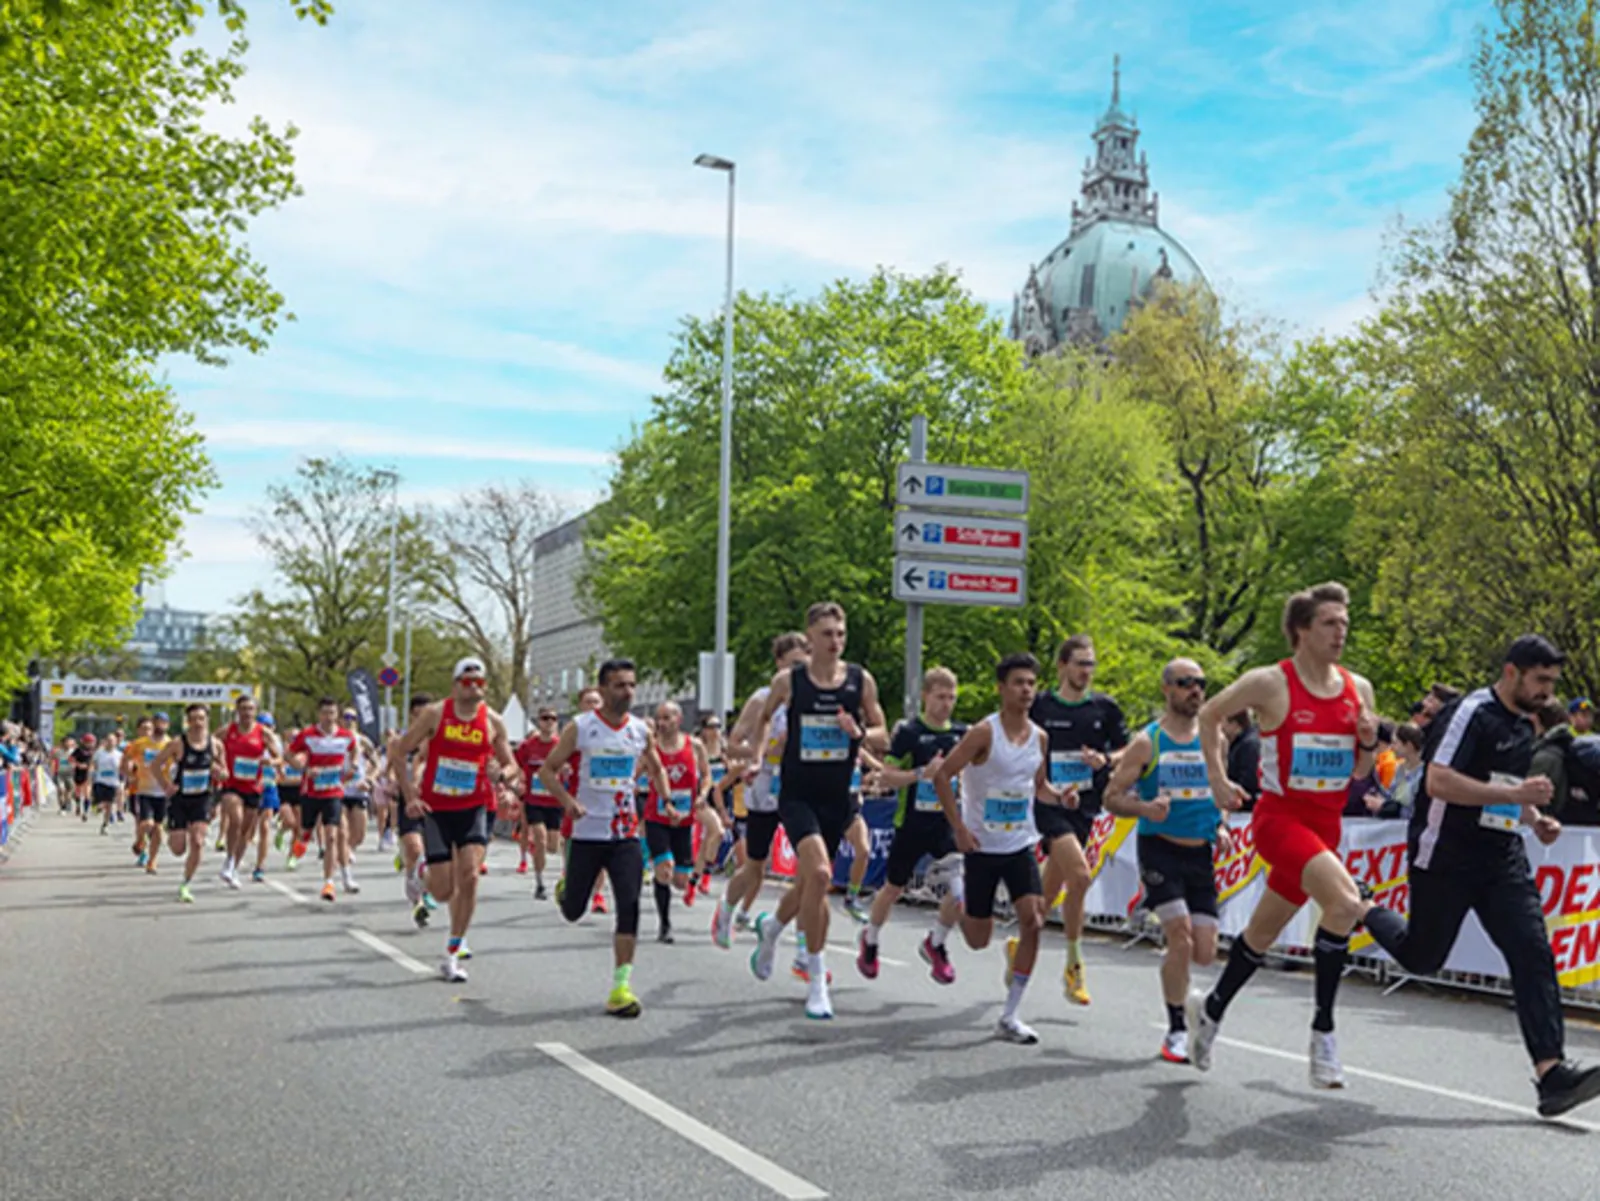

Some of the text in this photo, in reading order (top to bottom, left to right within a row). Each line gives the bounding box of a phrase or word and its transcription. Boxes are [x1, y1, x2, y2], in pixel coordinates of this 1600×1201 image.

[71, 685, 117, 697] START
[180, 687, 224, 699] START
[1336, 842, 1408, 886] EXT
